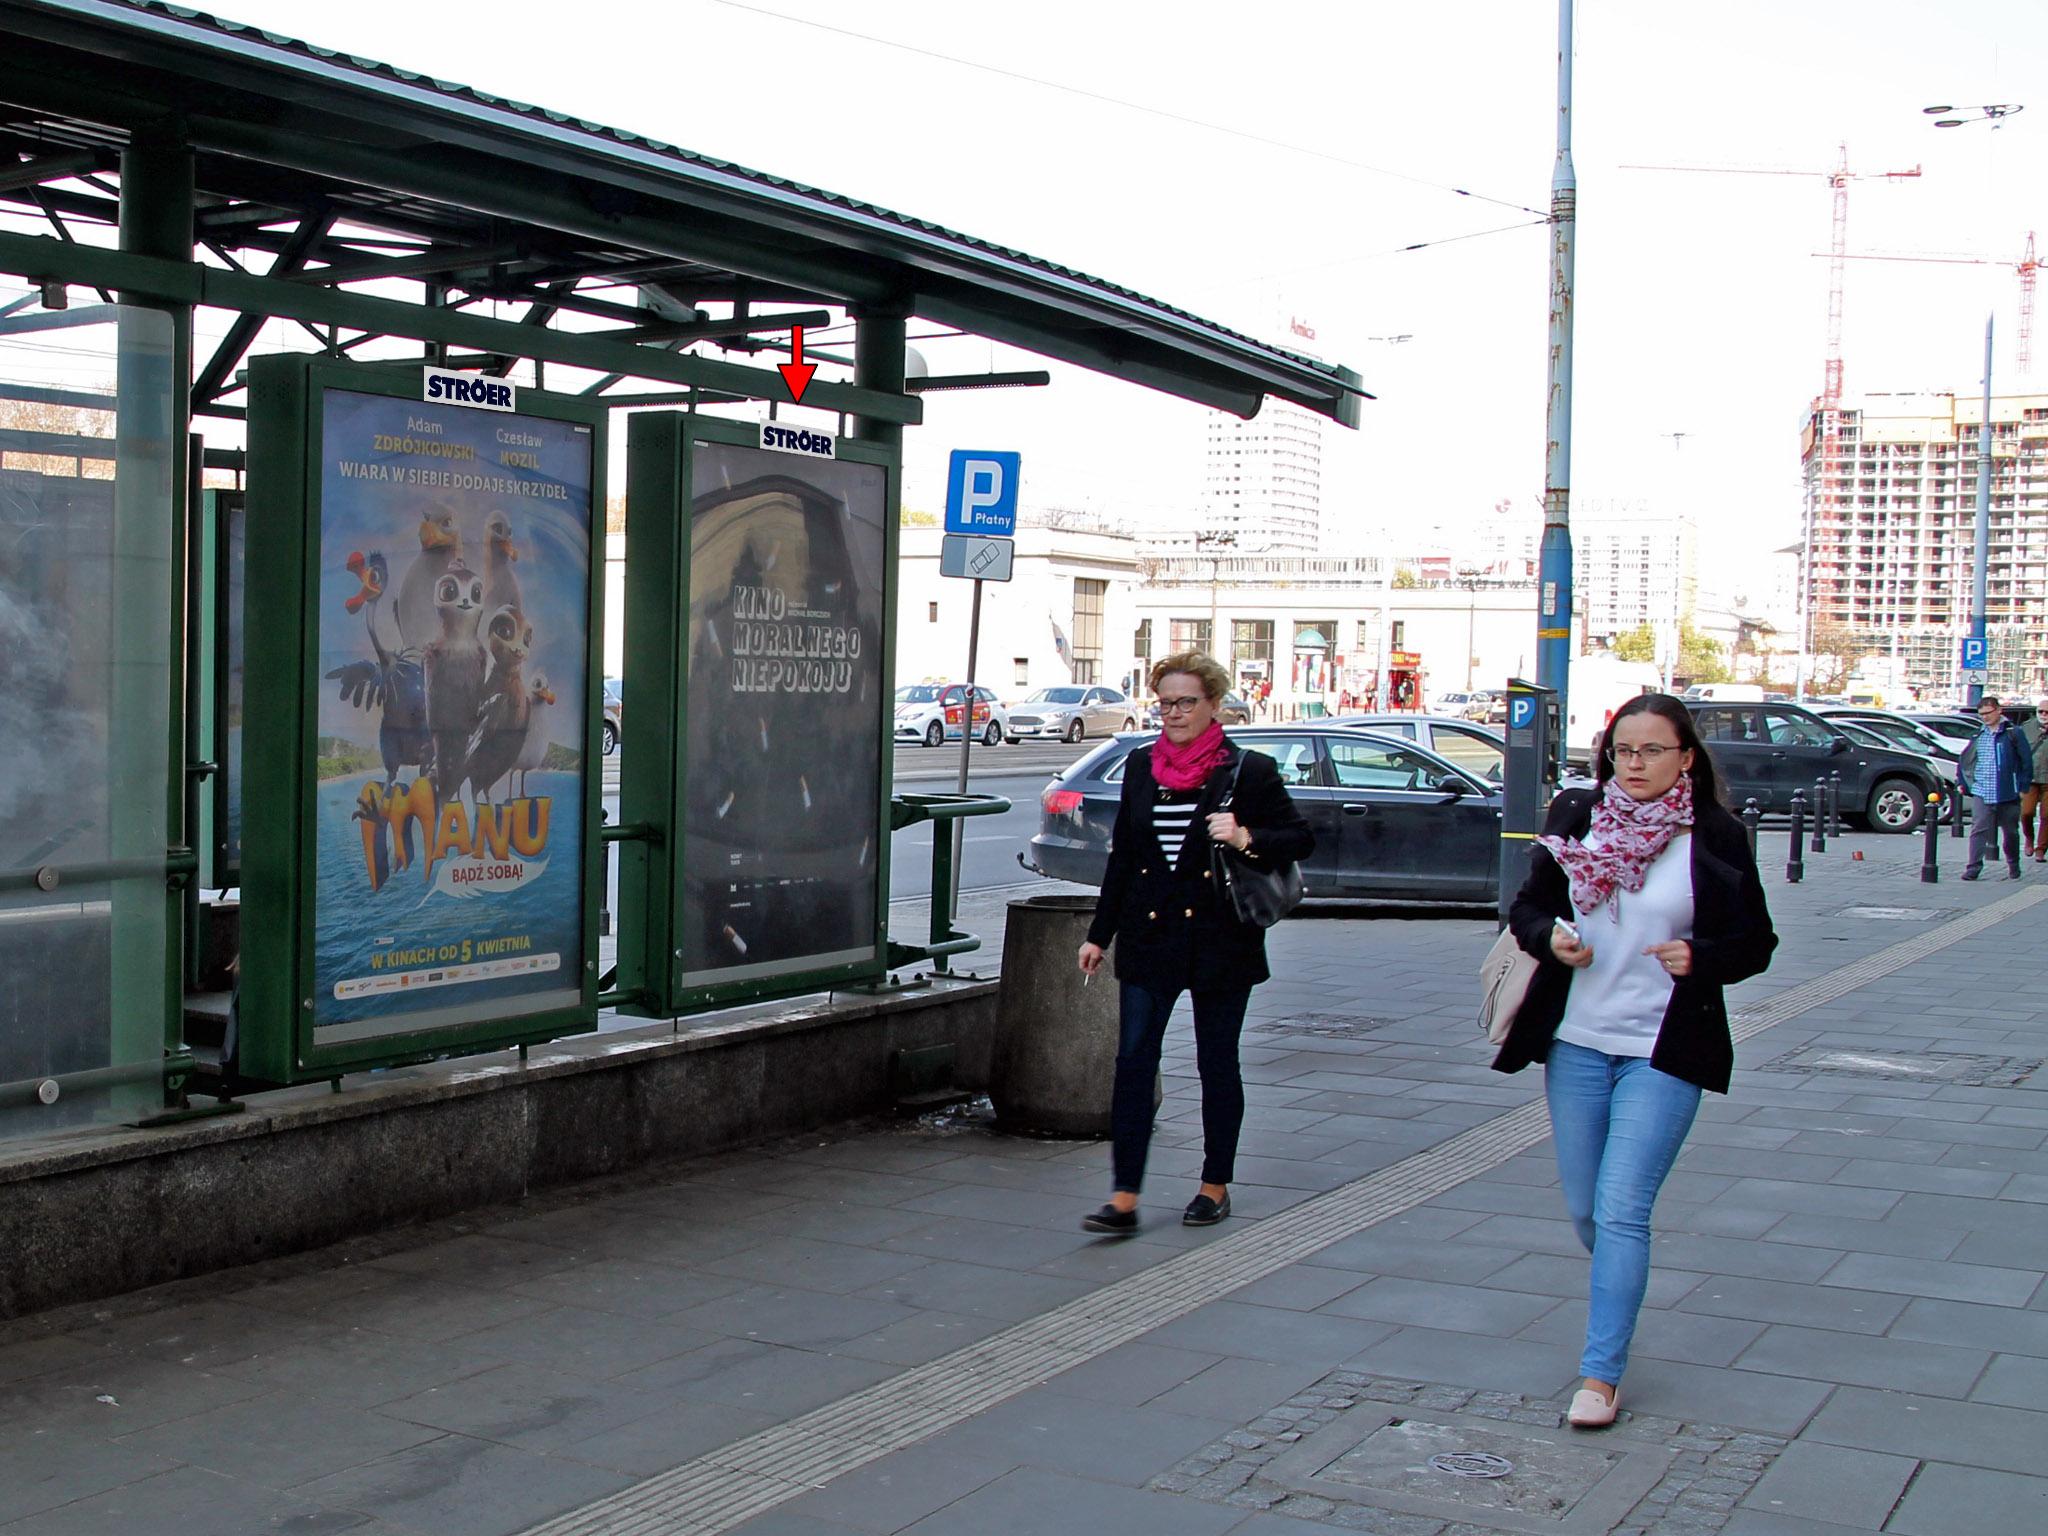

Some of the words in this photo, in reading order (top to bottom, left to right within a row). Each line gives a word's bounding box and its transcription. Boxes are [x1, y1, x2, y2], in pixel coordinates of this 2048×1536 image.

[1290, 314, 1316, 340] Amica
[428, 375, 511, 407] STRÖER
[407, 415, 443, 435] Adam
[496, 428, 543, 449] Czesław
[373, 434, 474, 461] ZDRÓJKOWSKI
[763, 425, 832, 456] STRÖER
[500, 450, 541, 470] MOZIL
[339, 460, 389, 481] WIARA
[392, 466, 406, 483] W
[408, 468, 450, 488] SIEBIE
[453, 473, 504, 494] DODAJE
[506, 479, 568, 501] SKRZYDEŁ
[961, 460, 1003, 524] P
[975, 512, 1011, 529] Płatny
[733, 585, 785, 621] KINO
[732, 622, 860, 659] MORALNEGO
[1966, 640, 1982, 660] P
[732, 658, 852, 694] NIEPOKOJU
[1513, 700, 1528, 723] P
[361, 776, 552, 892] MANU
[452, 863, 484, 886] BĄDŹ
[487, 863, 524, 881] SOBĄ!
[371, 952, 384, 969] W
[387, 947, 435, 968] KINACH
[439, 944, 459, 961] OD
[461, 939, 473, 963] 5
[477, 935, 531, 957] KWIETNIA
